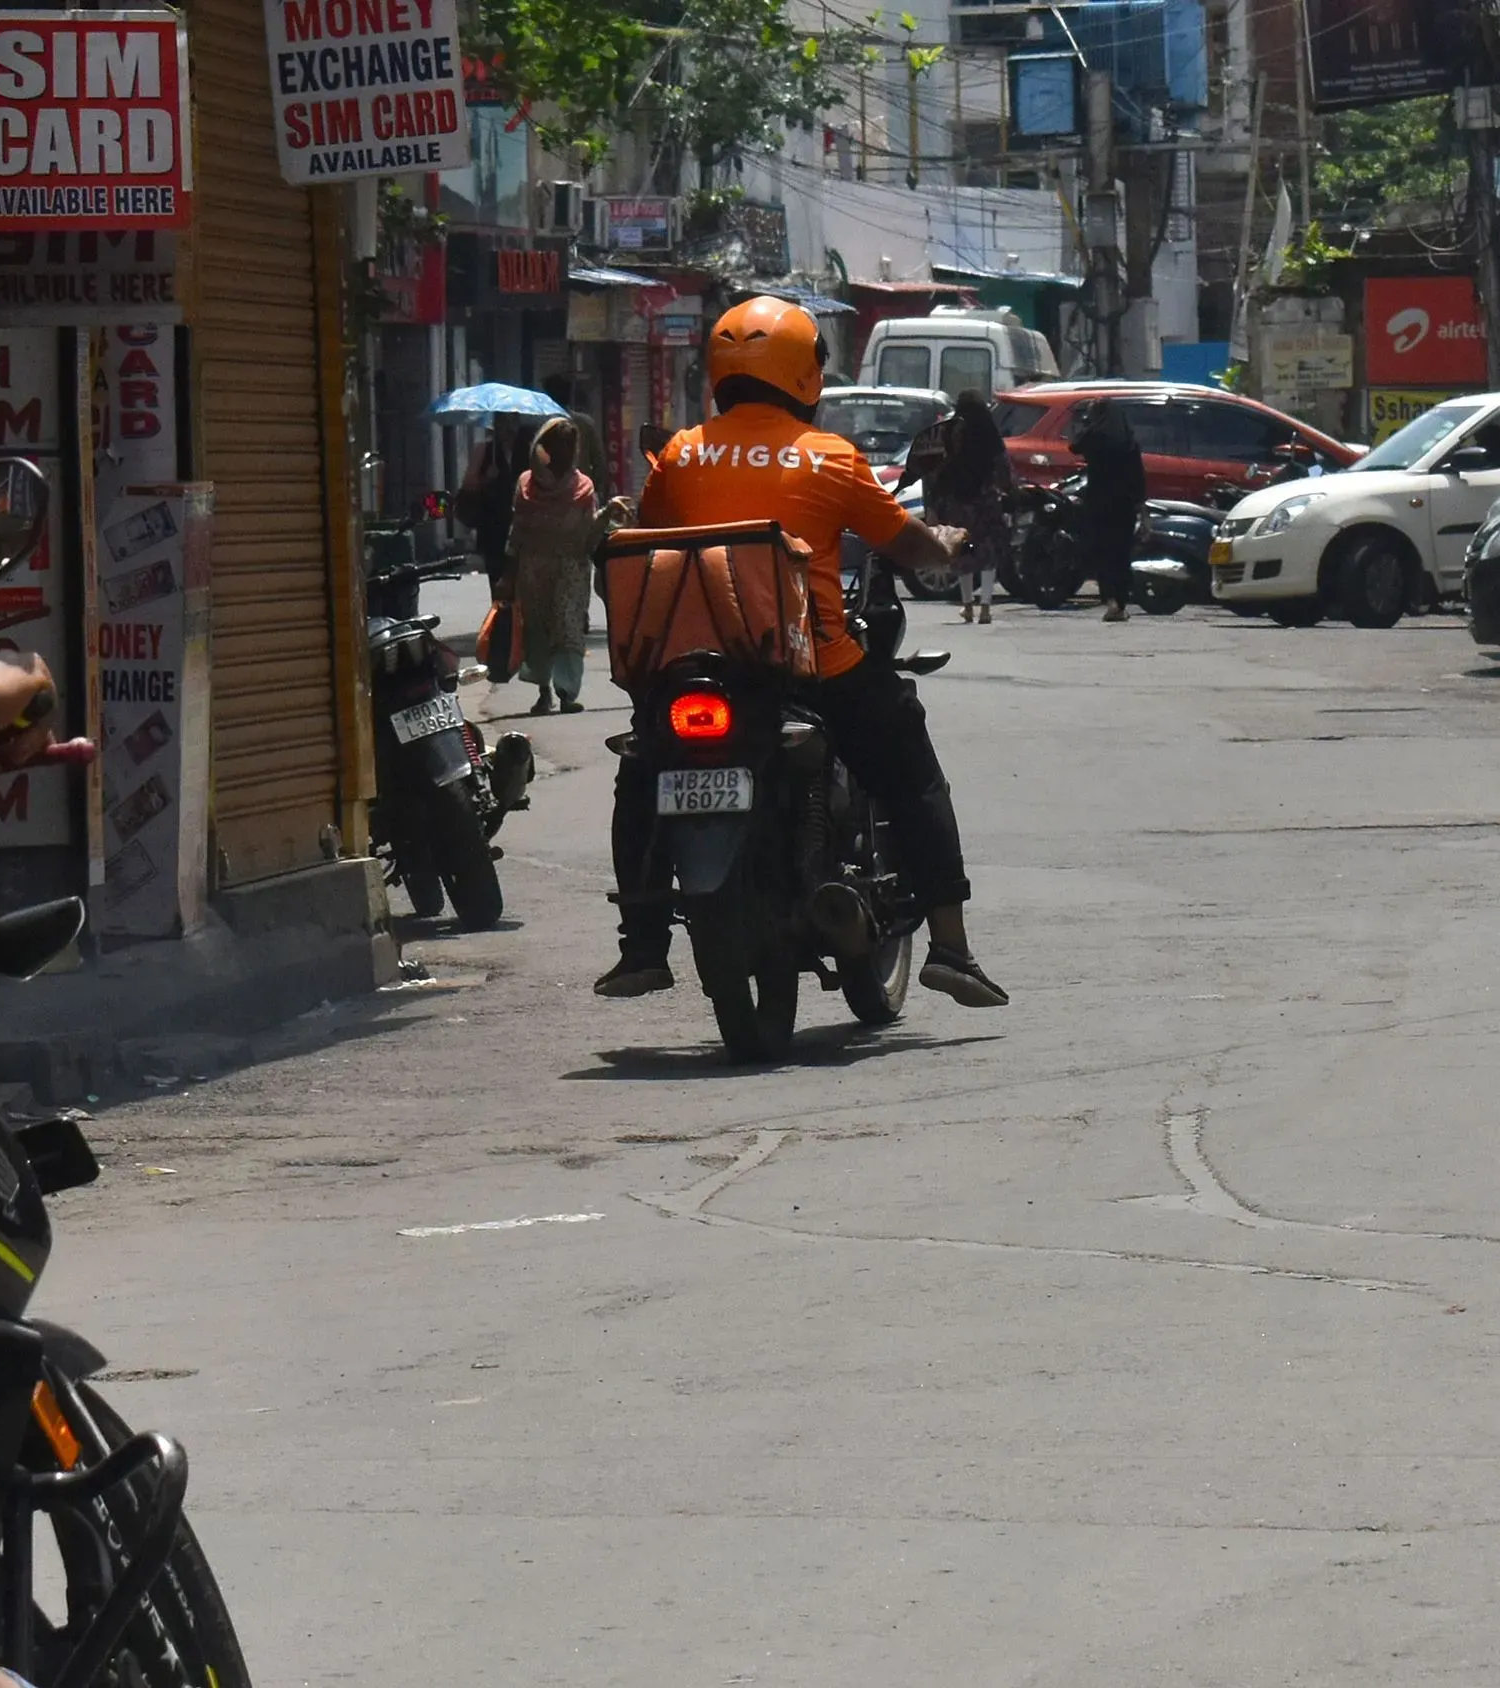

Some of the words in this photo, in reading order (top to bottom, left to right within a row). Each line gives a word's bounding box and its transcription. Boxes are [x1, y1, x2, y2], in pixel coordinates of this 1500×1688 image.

[283, 0, 433, 43] MONEY
[277, 37, 454, 95] EXCHANGE
[283, 97, 363, 149] SIM
[371, 88, 458, 141] CARD
[309, 142, 441, 175] AVAILABLE
[113, 185, 175, 216] HERE
[110, 272, 175, 303] HERE
[1437, 321, 1488, 339] airtel
[677, 444, 827, 474] SWIGGY
[99, 623, 164, 660] ONEY
[102, 669, 175, 702] HANGE
